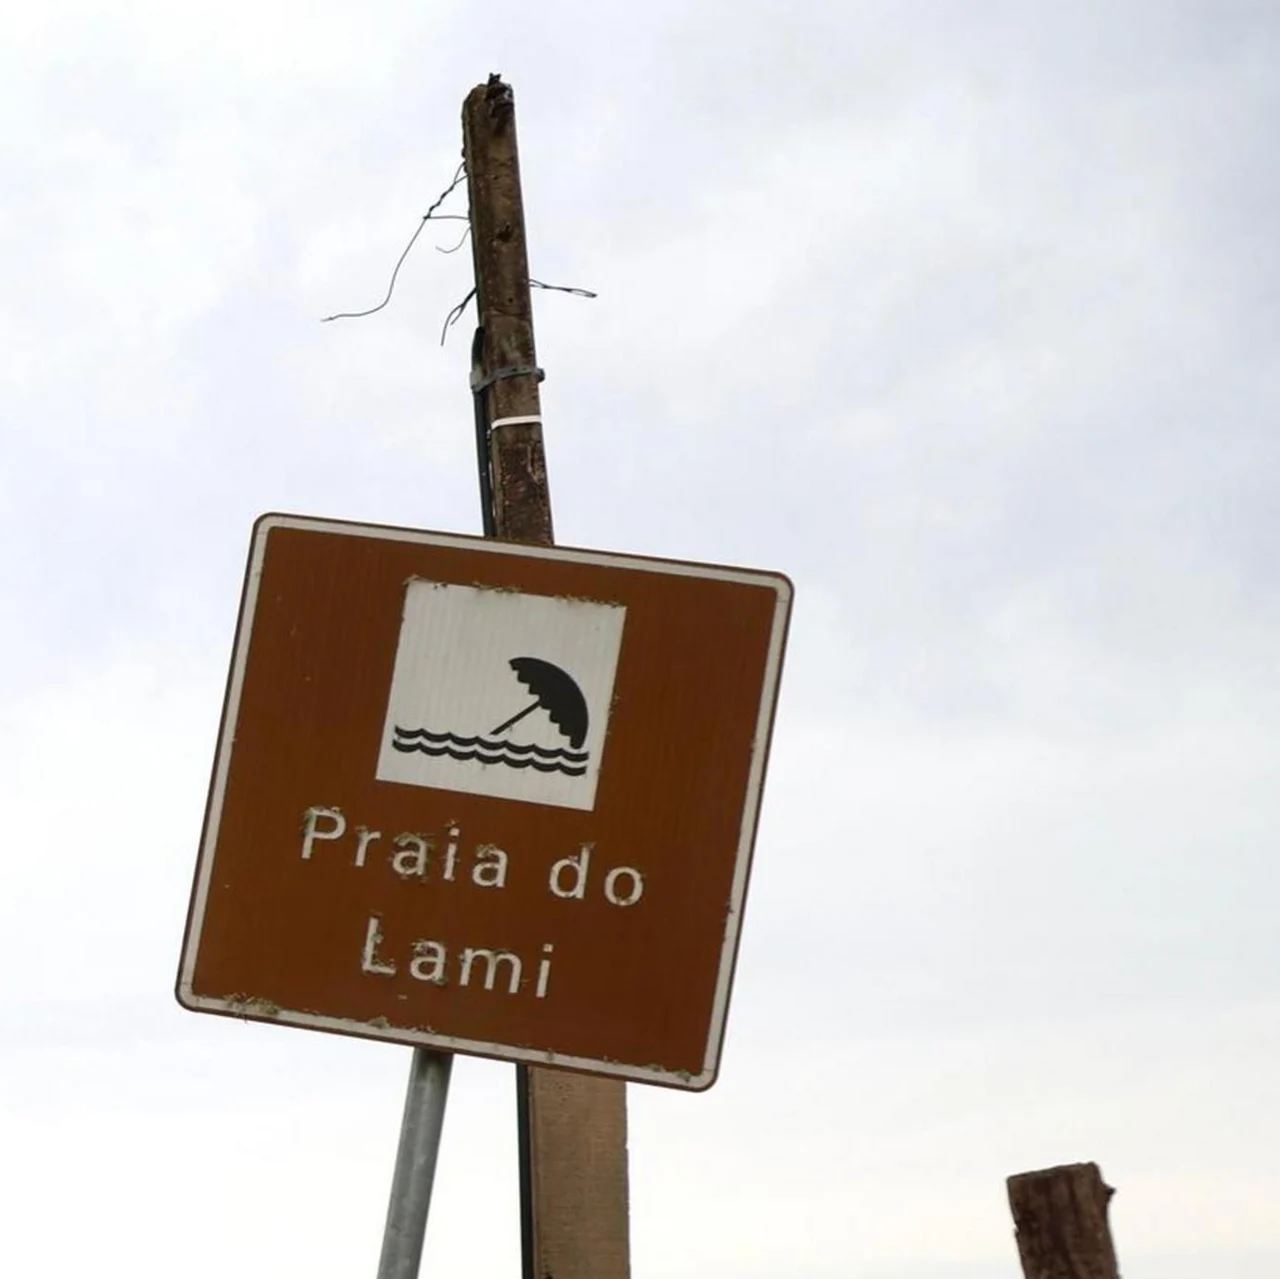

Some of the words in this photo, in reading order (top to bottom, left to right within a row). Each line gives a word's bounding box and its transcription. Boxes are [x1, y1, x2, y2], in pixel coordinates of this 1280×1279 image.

[300, 806, 509, 888] Praia
[548, 844, 644, 906] do
[360, 914, 554, 998] Lami
